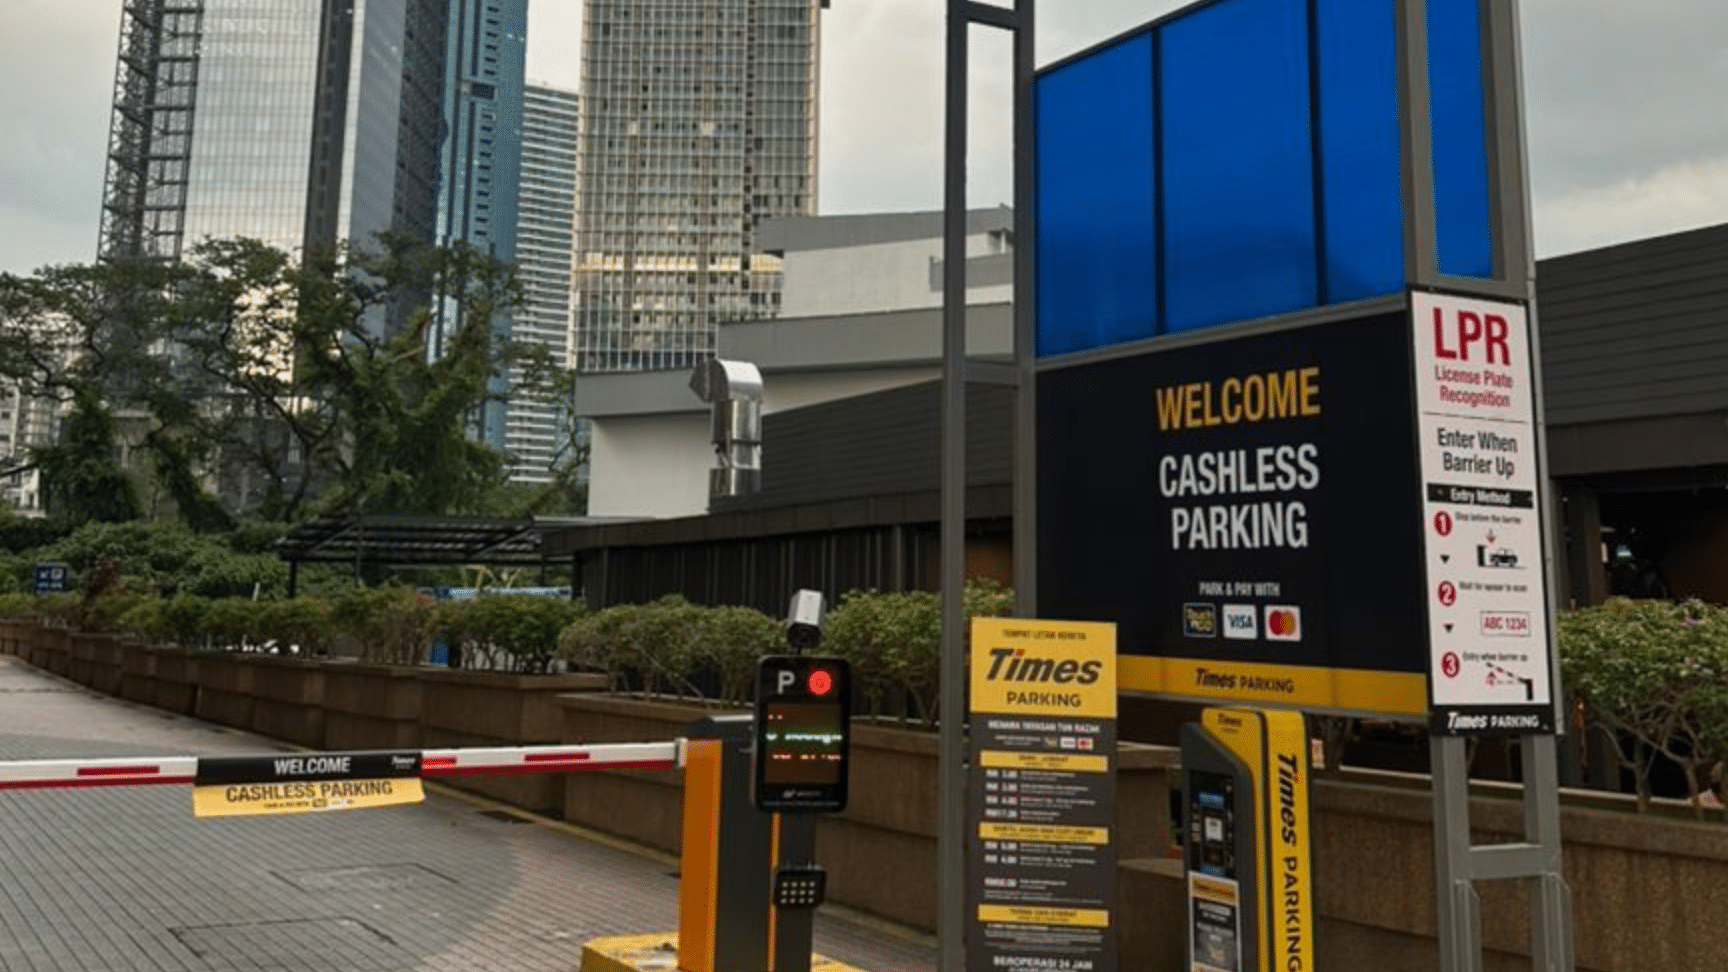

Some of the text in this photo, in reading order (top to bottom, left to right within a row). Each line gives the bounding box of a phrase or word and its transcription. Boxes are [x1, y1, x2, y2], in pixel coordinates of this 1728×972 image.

[1433, 306, 1511, 367] LPR
[1435, 365, 1514, 389] License Plate
[1155, 366, 1321, 431] WELCOME
[1439, 385, 1511, 408] Recognition
[1437, 427, 1518, 453] Enter When
[1158, 443, 1320, 498] CASHLESS
[1442, 451, 1515, 480] Barrier Up
[1450, 487, 1511, 505] Entry Method
[1171, 501, 1309, 550] PARKING
[1198, 581, 1224, 596] PARK
[1227, 614, 1253, 629] VISA
[1484, 616, 1527, 631] ABC 1234
[986, 647, 1103, 685] Times
[777, 670, 796, 695] P
[1196, 666, 1295, 694] Times PARKING
[1006, 690, 1082, 708] PARKING
[1447, 711, 1540, 730] Times PARKING
[274, 757, 352, 776] WELCOME
[225, 780, 393, 803] CASHLESS PARKING
[1278, 752, 1304, 847] Times
[1282, 855, 1303, 972] PARKING
